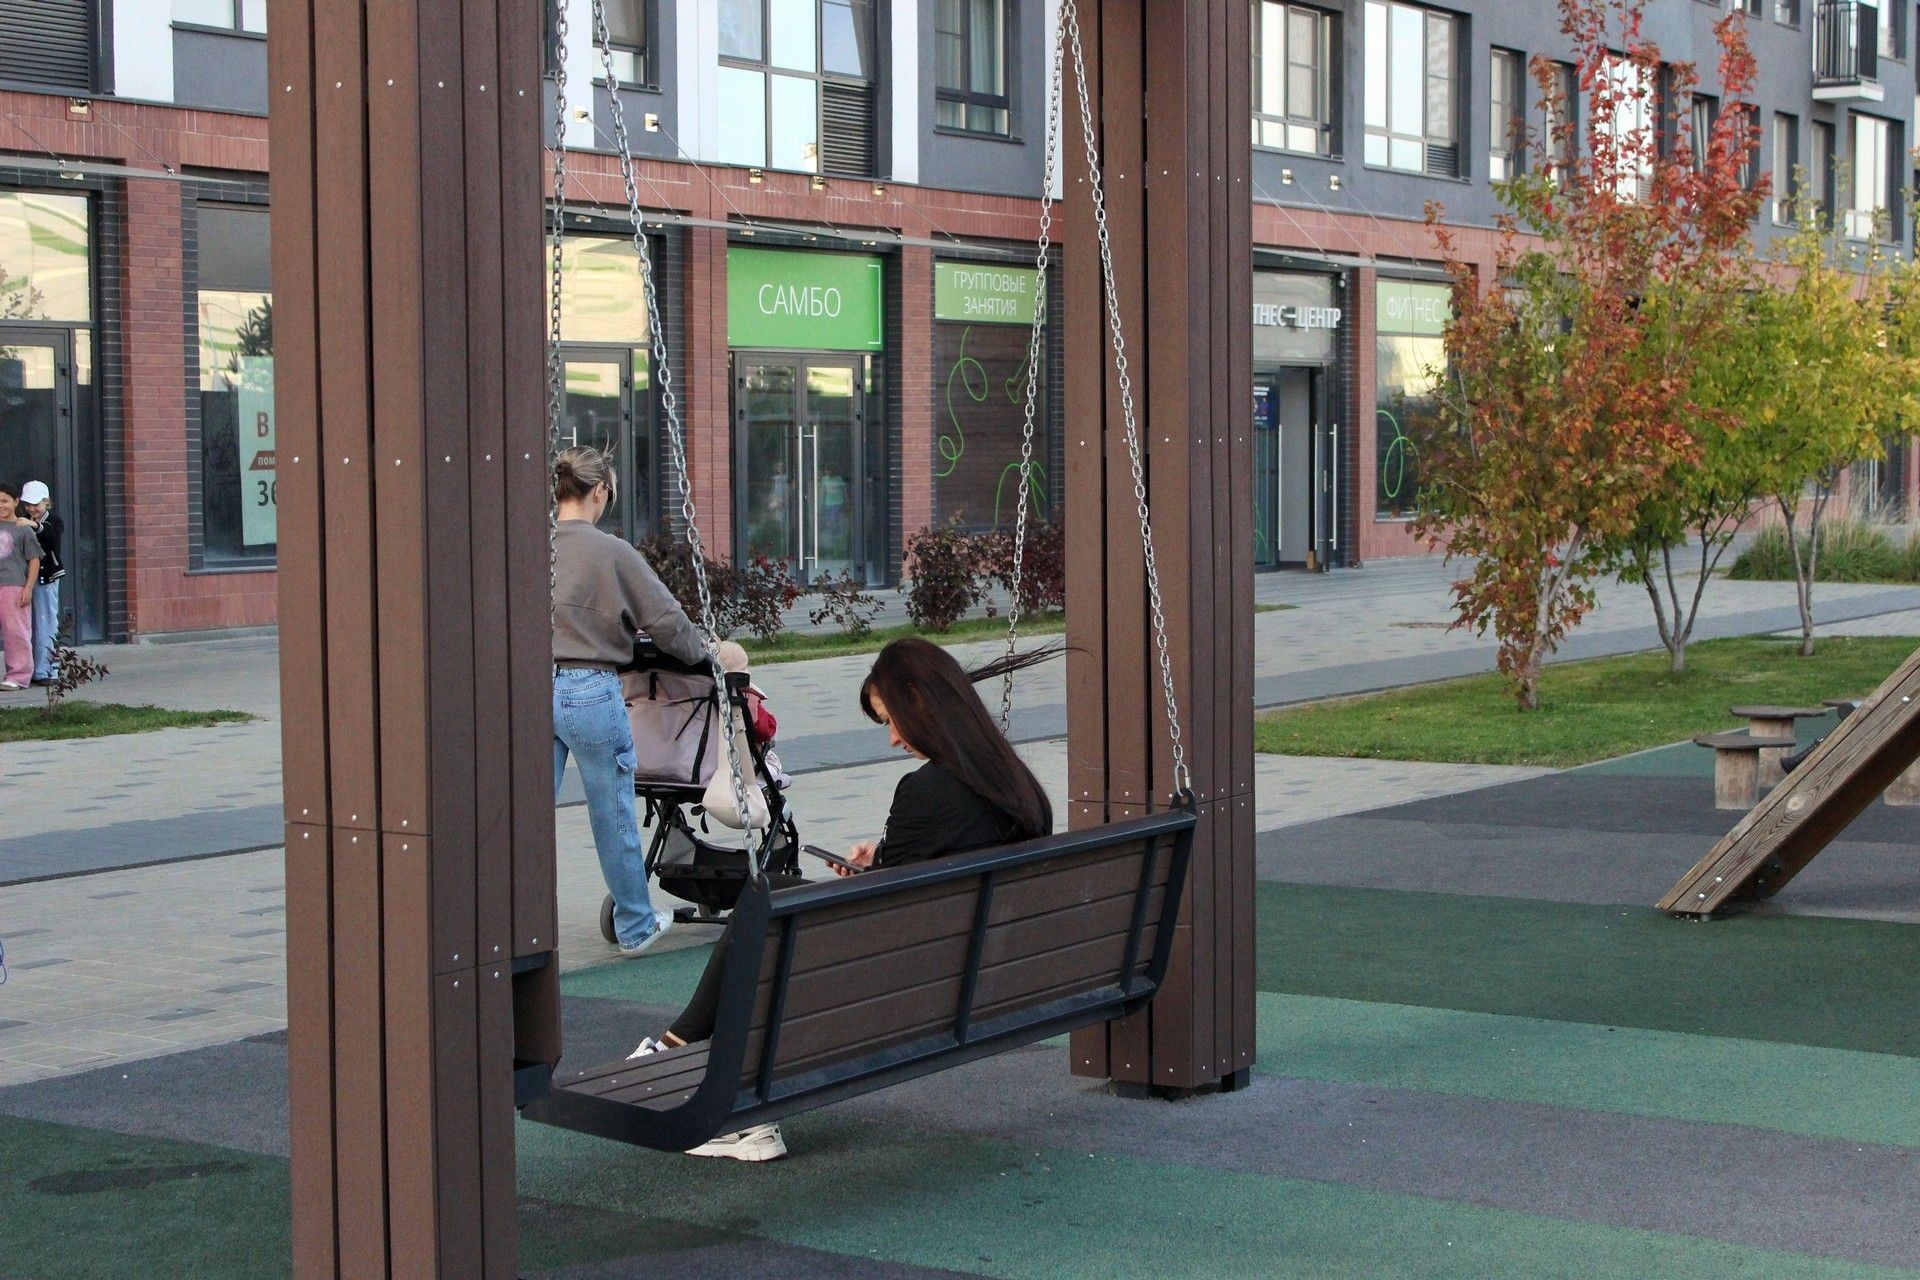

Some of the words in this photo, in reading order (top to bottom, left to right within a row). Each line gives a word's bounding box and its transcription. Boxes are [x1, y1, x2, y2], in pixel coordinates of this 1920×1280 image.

[953, 270, 1027, 293] ГРУППОВЫЕ
[758, 283, 842, 318] САМБО
[963, 296, 1018, 317] ЗАНЯТИЯ
[1387, 297, 1441, 323] ФИТНЕС
